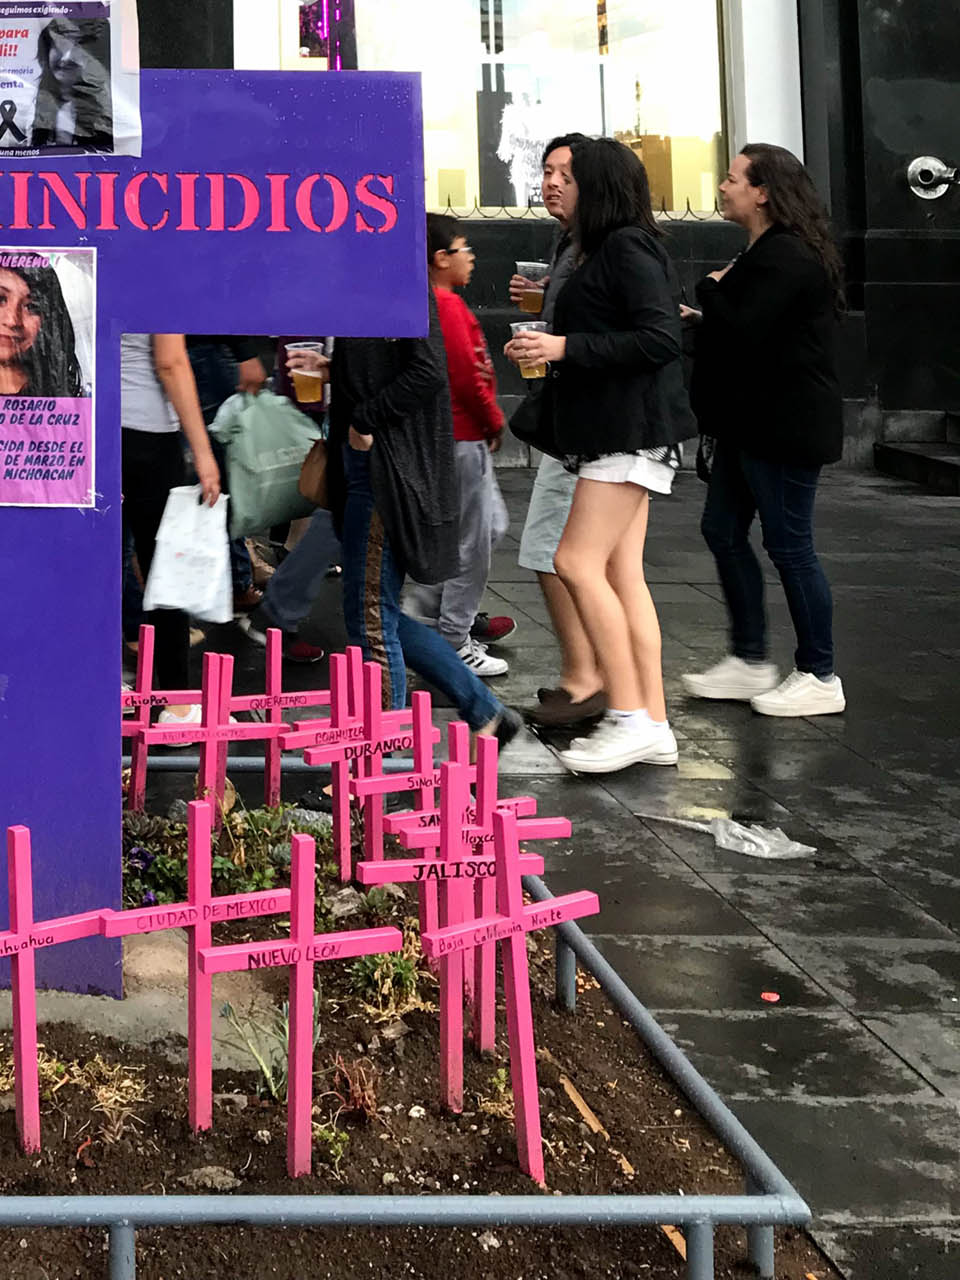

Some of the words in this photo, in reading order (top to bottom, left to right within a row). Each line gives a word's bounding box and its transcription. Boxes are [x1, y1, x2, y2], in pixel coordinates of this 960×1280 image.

[33, 5, 68, 15] exigiendo
[0, 149, 14, 157] una
[15, 148, 40, 157] menos
[2, 399, 57, 412] ROSARIO
[10, 412, 26, 425] DE
[28, 413, 43, 425] LA
[47, 413, 81, 426] CRUZ
[28, 440, 67, 453] DESDE
[70, 441, 84, 453] EL
[4, 454, 20, 466] DE
[68, 455, 86, 467] EN
[3, 468, 75, 481] MICHOACAN
[343, 736, 413, 761] DURANGO
[413, 860, 497, 881] JALISCO
[136, 908, 198, 931] CIUDAD
[202, 904, 220, 921] DE
[226, 897, 277, 917] MEXICO
[247, 946, 302, 970] NUEVO
